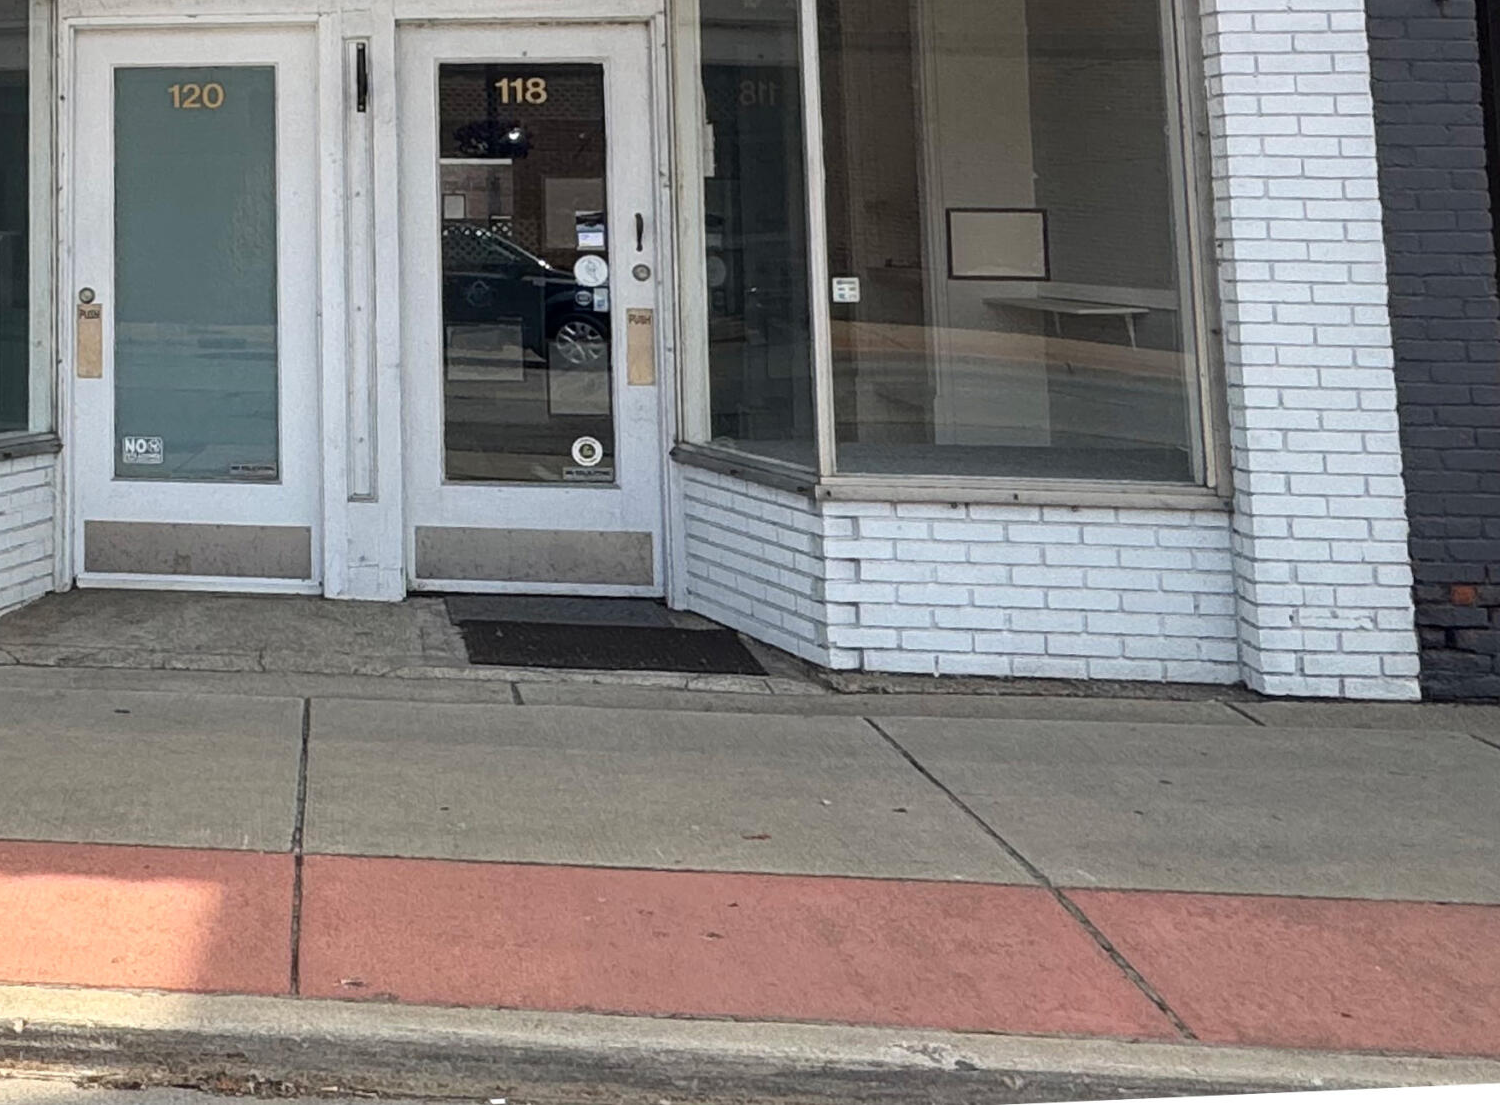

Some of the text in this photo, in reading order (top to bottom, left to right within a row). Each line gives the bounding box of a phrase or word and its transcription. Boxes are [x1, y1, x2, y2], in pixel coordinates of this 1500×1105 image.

[168, 82, 225, 109] 120
[495, 76, 548, 104] 118
[125, 438, 147, 453] NO
